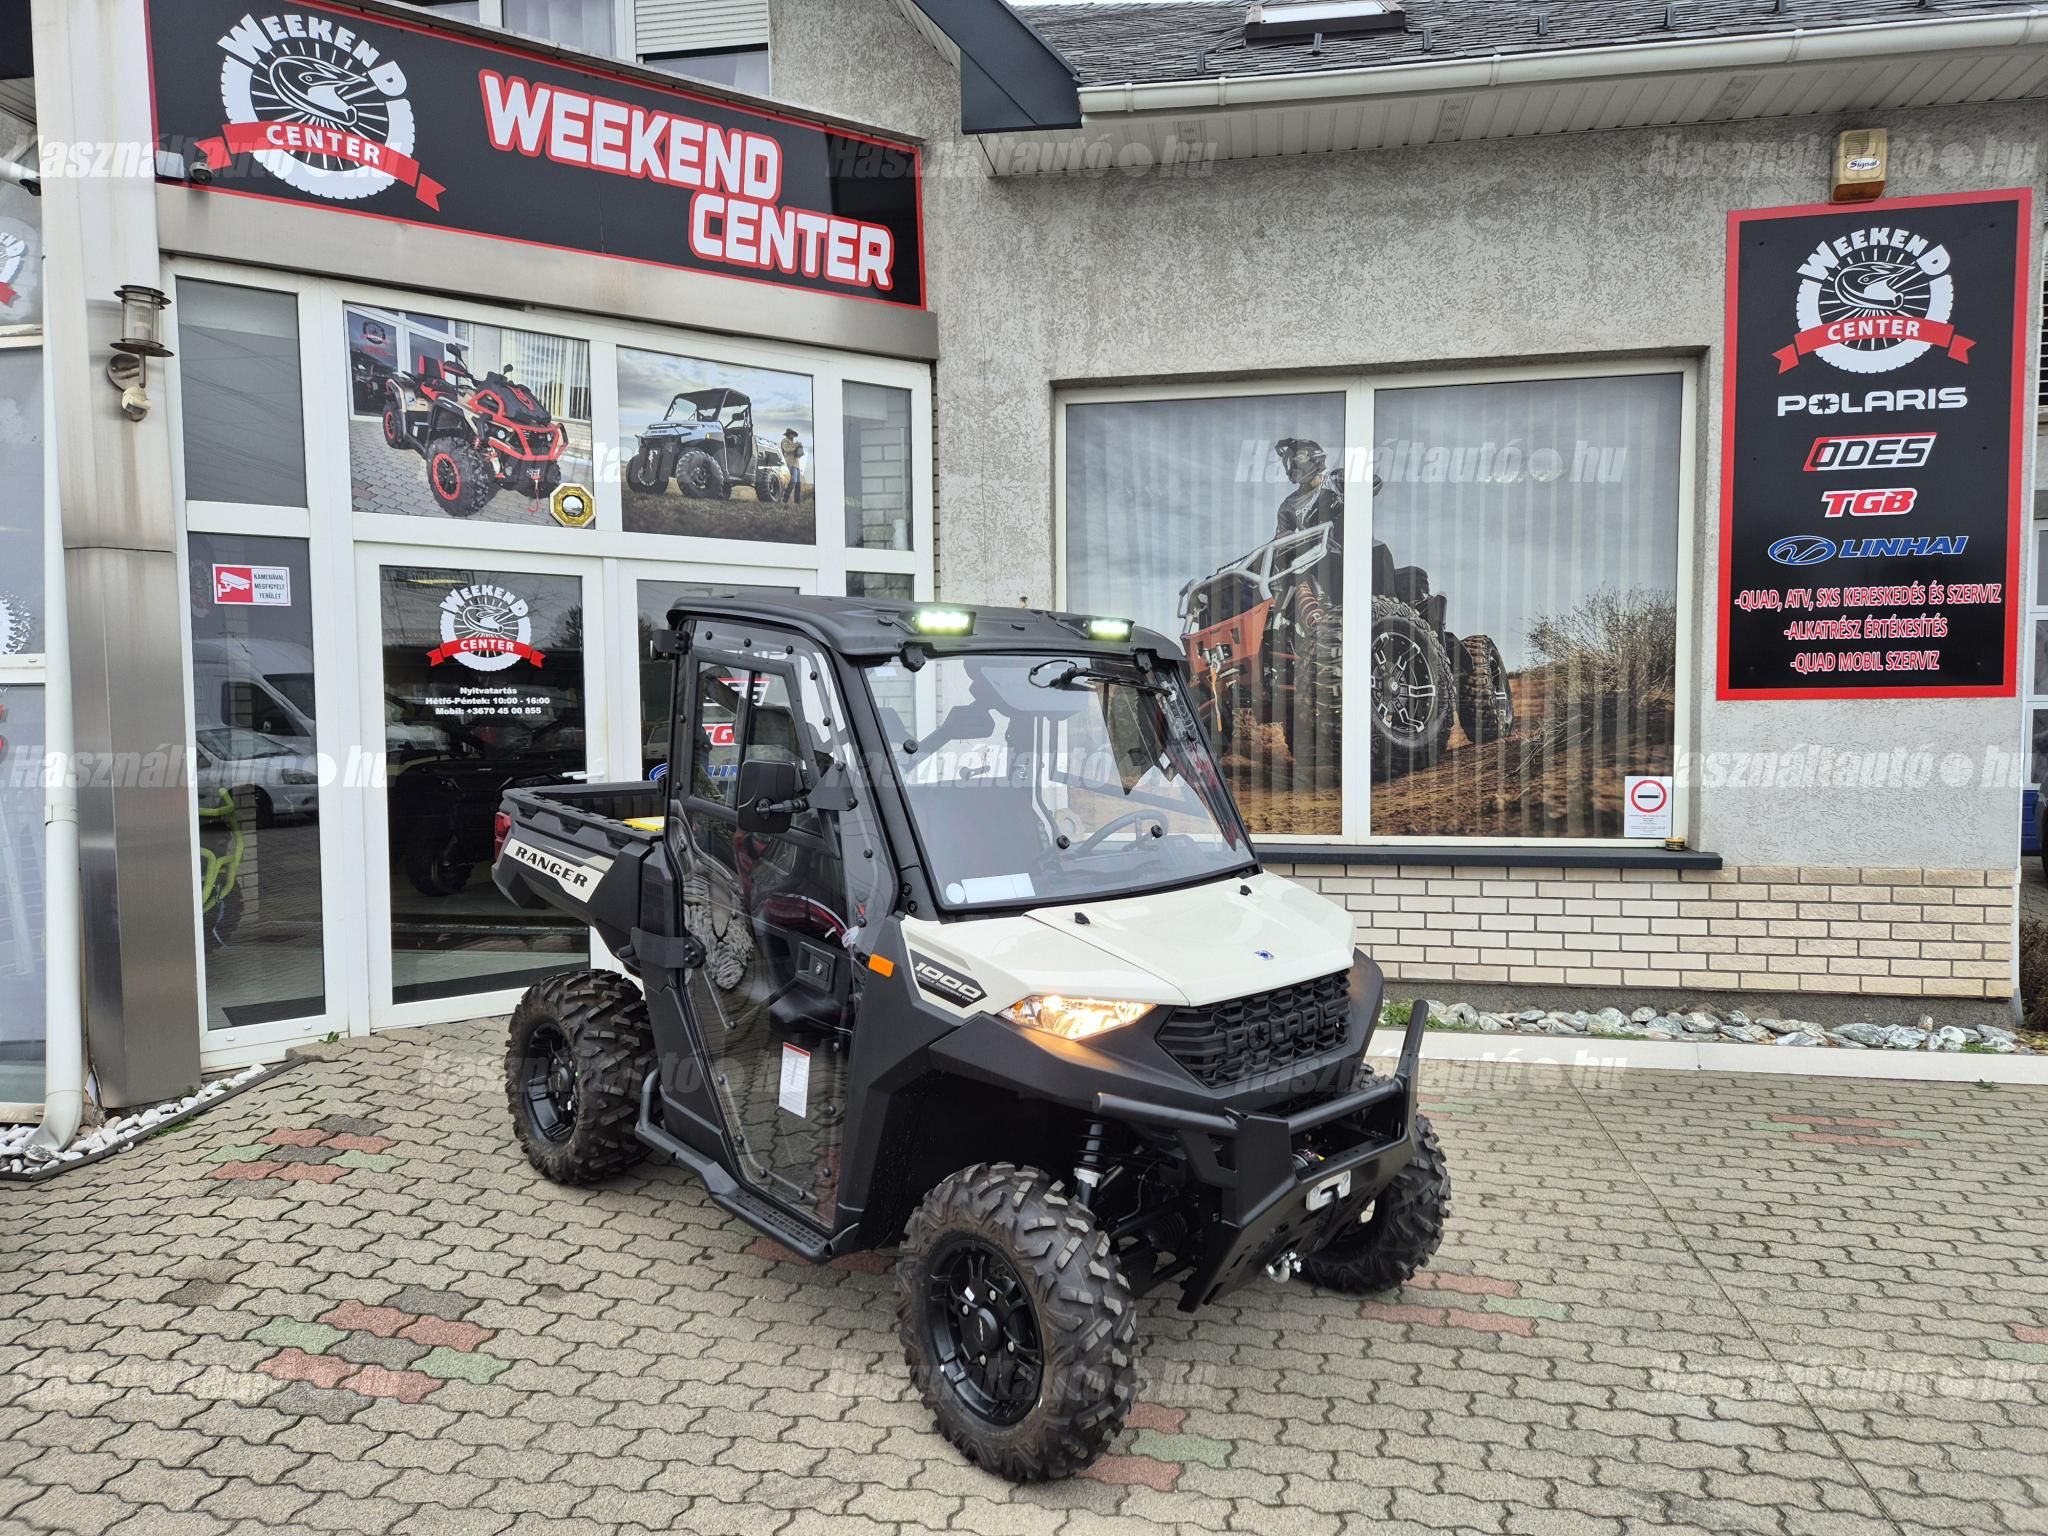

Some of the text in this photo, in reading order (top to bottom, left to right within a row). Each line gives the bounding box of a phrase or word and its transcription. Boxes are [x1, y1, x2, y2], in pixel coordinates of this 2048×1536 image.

[217, 13, 408, 97] WEEKEND
[266, 124, 381, 165] CENTER
[482, 74, 778, 199] WEEKEND
[1850, 160, 1877, 168] Signal
[693, 194, 891, 286] CENTER
[1796, 227, 1950, 281] WEEKEND
[1827, 319, 1920, 341] CENTER
[1777, 387, 1968, 416] POLARIS
[1808, 436, 1931, 470] ODES
[1821, 488, 1917, 518] TGB
[1839, 536, 1968, 558] LINHAI
[439, 584, 529, 617] WEEKEND
[1735, 580, 2001, 612] -QUAD, ATV, SXS KERESKEDÉS ÉS SZERVIZ
[1783, 613, 1948, 640] -ALKATRÉSZ ÉRTÉKESÍTÉS
[460, 639, 514, 652] CENTER
[1790, 651, 1940, 674] -QUAD MOBIL SZERVIZ
[460, 687, 517, 695] Nyitvatartás
[515, 846, 588, 887] RANGER
[915, 962, 981, 999] 1000
[1226, 1002, 1338, 1054] POLARIS
